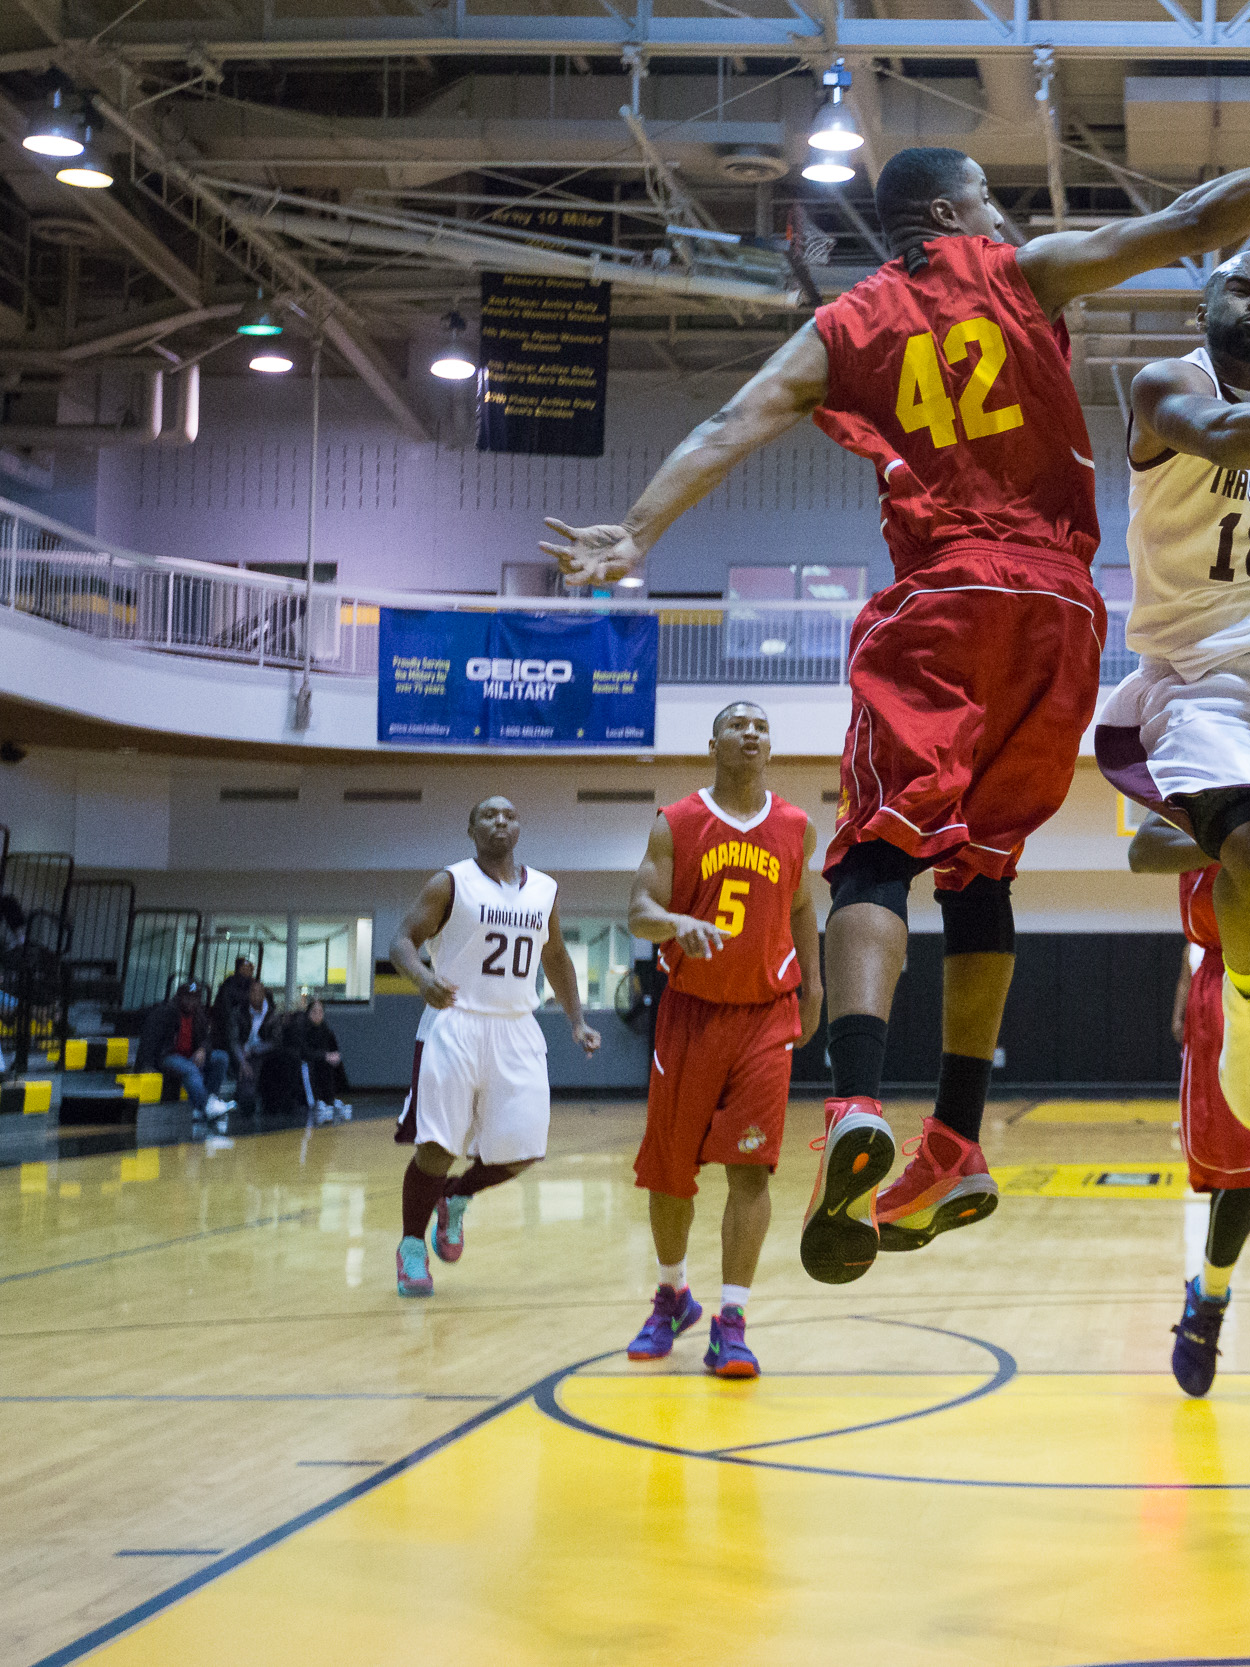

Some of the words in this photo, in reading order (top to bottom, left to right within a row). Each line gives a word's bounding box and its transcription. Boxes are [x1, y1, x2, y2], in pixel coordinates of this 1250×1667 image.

[895, 316, 1024, 449] 42
[466, 657, 573, 683] GEICO
[483, 680, 557, 700] MILITARY
[701, 840, 780, 884] MARINES
[479, 904, 543, 931] TRAVELLERS
[715, 878, 750, 938] 5
[481, 932, 534, 978] 20
